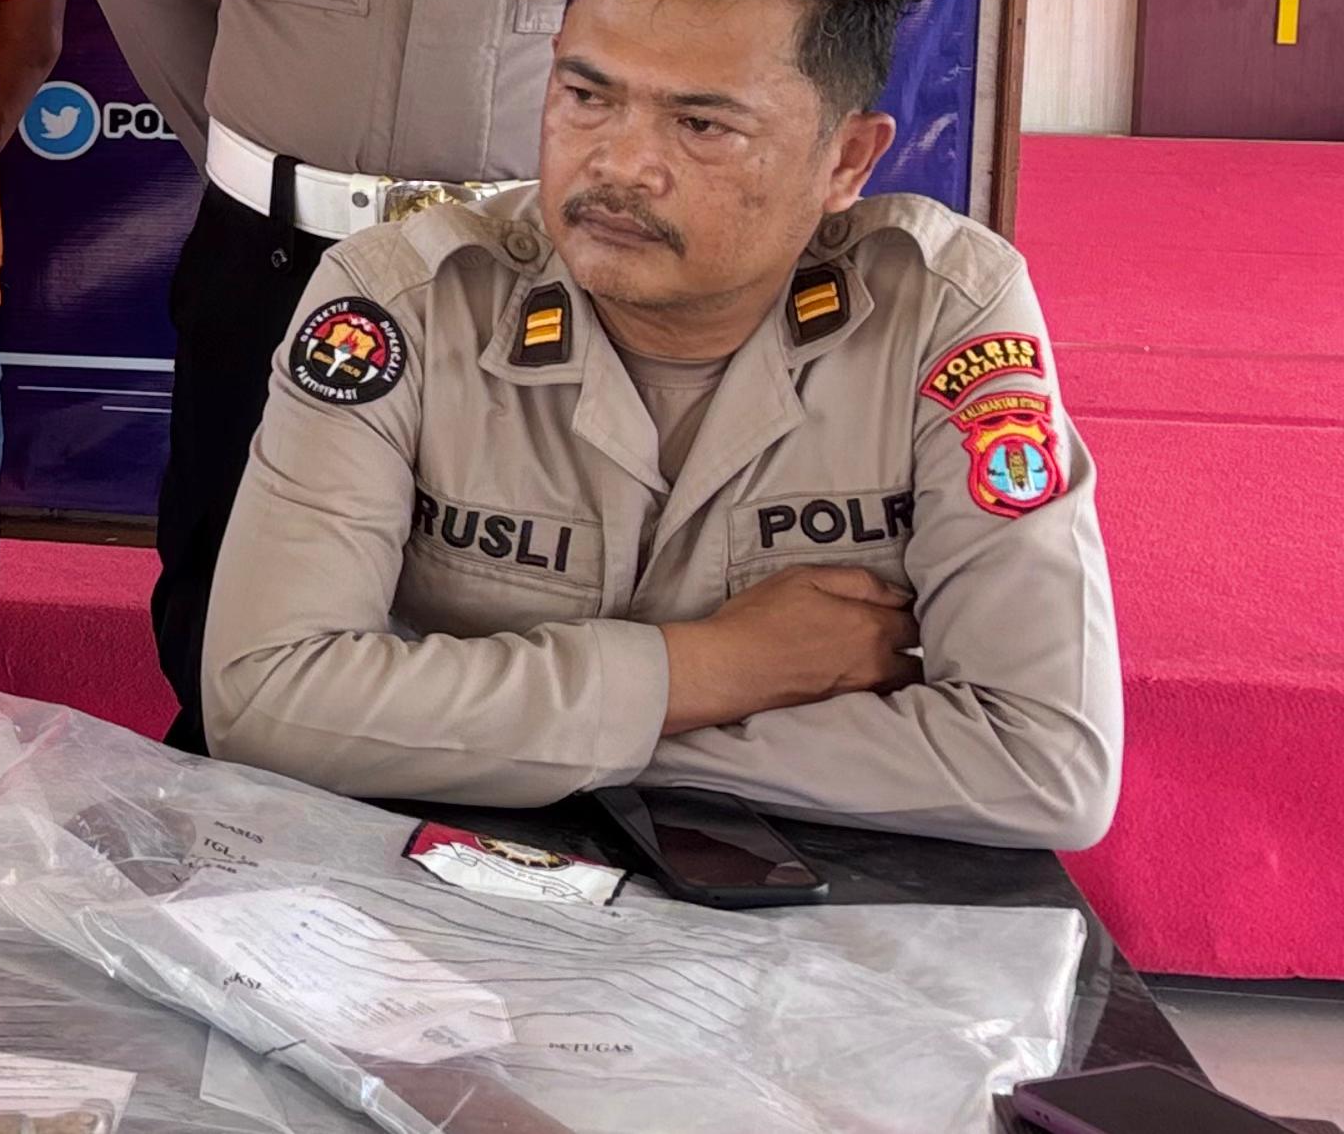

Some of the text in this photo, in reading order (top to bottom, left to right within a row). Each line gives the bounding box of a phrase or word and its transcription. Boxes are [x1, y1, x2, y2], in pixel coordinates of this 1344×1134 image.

[931, 339, 1036, 392] POLRES
[949, 353, 1033, 393] TARAKAN
[413, 490, 572, 573] RUSLI
